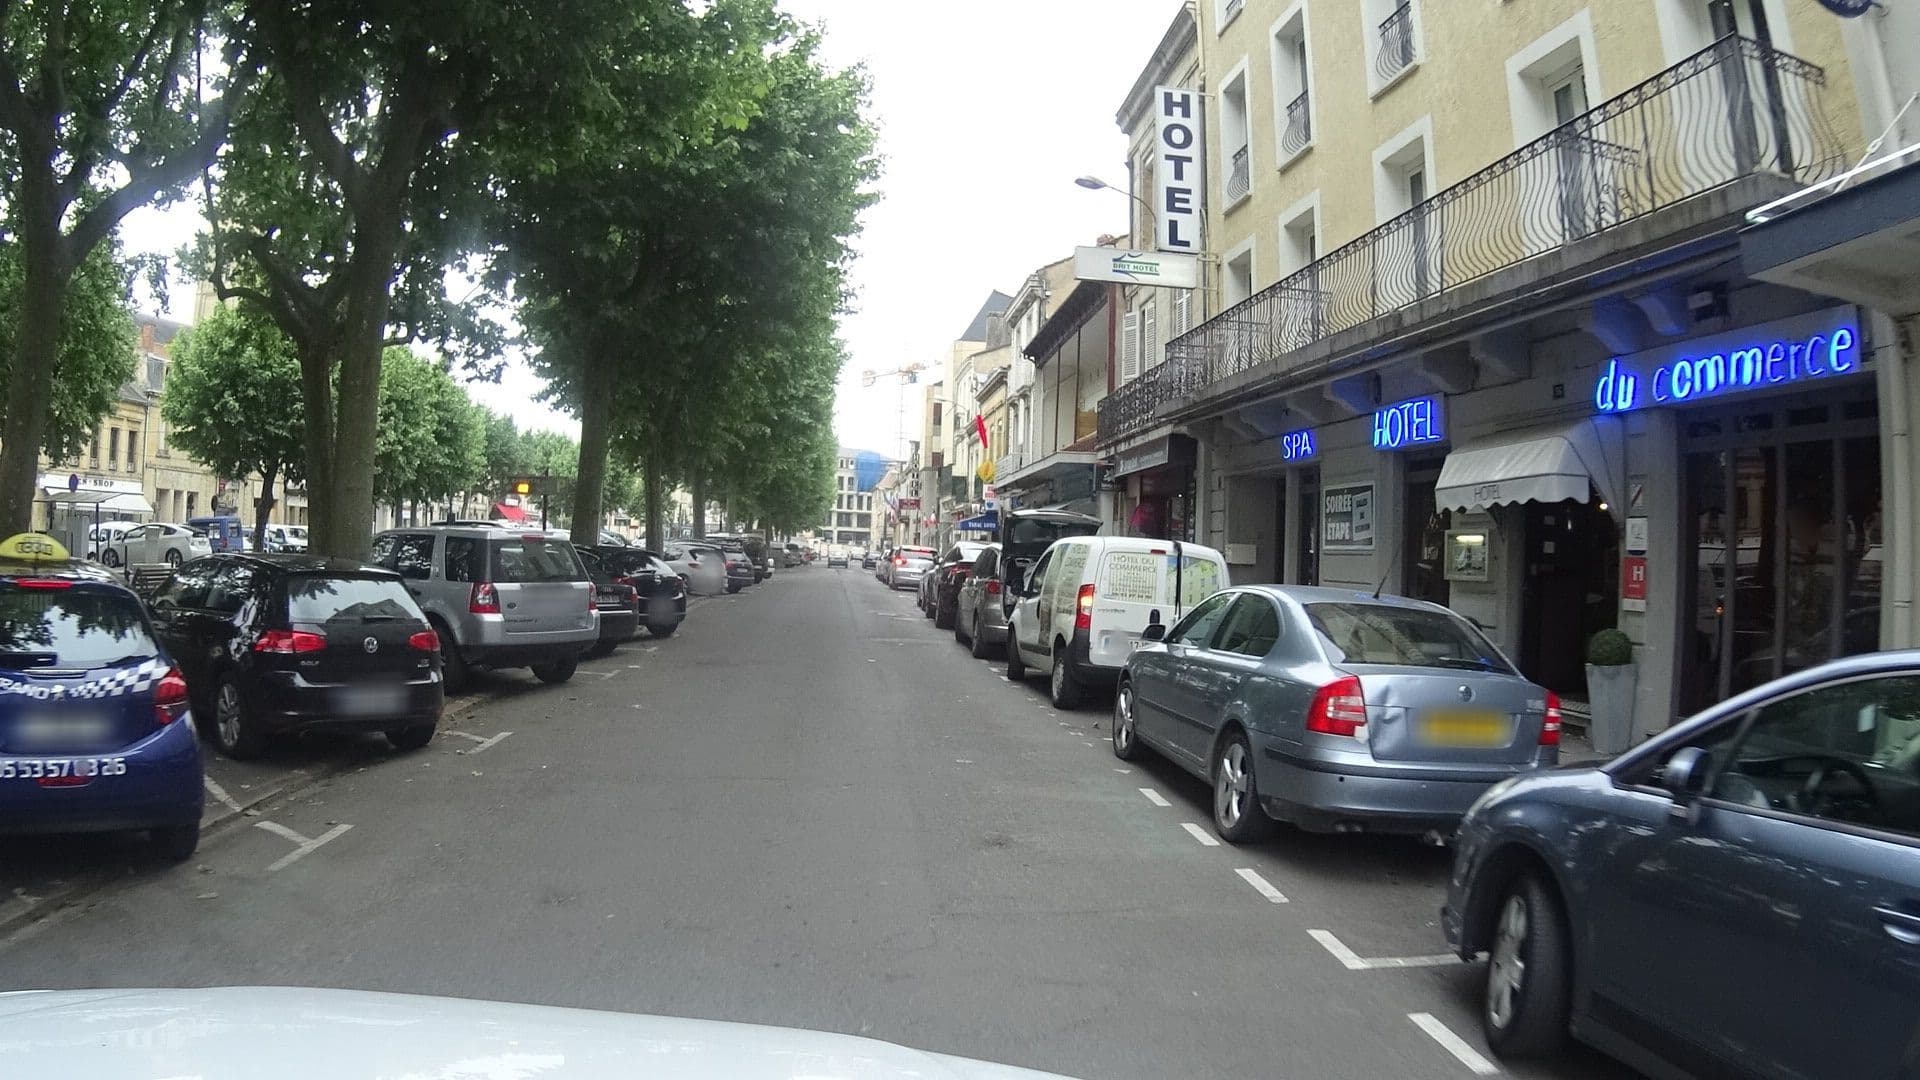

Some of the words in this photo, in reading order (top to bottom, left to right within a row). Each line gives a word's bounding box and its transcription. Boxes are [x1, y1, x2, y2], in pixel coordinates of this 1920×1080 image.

[1163, 92, 1193, 248] HOTEL
[1132, 264, 1158, 272] HOTEL
[1596, 359, 1635, 410] du
[1652, 328, 1853, 400] commerce
[1374, 400, 1440, 447] HOTEL
[1283, 432, 1312, 459] SPA
[93, 479, 114, 488] SHOP
[1473, 484, 1501, 502] HOTEL
[1326, 490, 1352, 513] SOIRÉE
[1327, 517, 1350, 540] ÉTAPE
[1632, 566, 1645, 582] H
[19, 760, 44, 778] 53
[46, 760, 71, 777] 57
